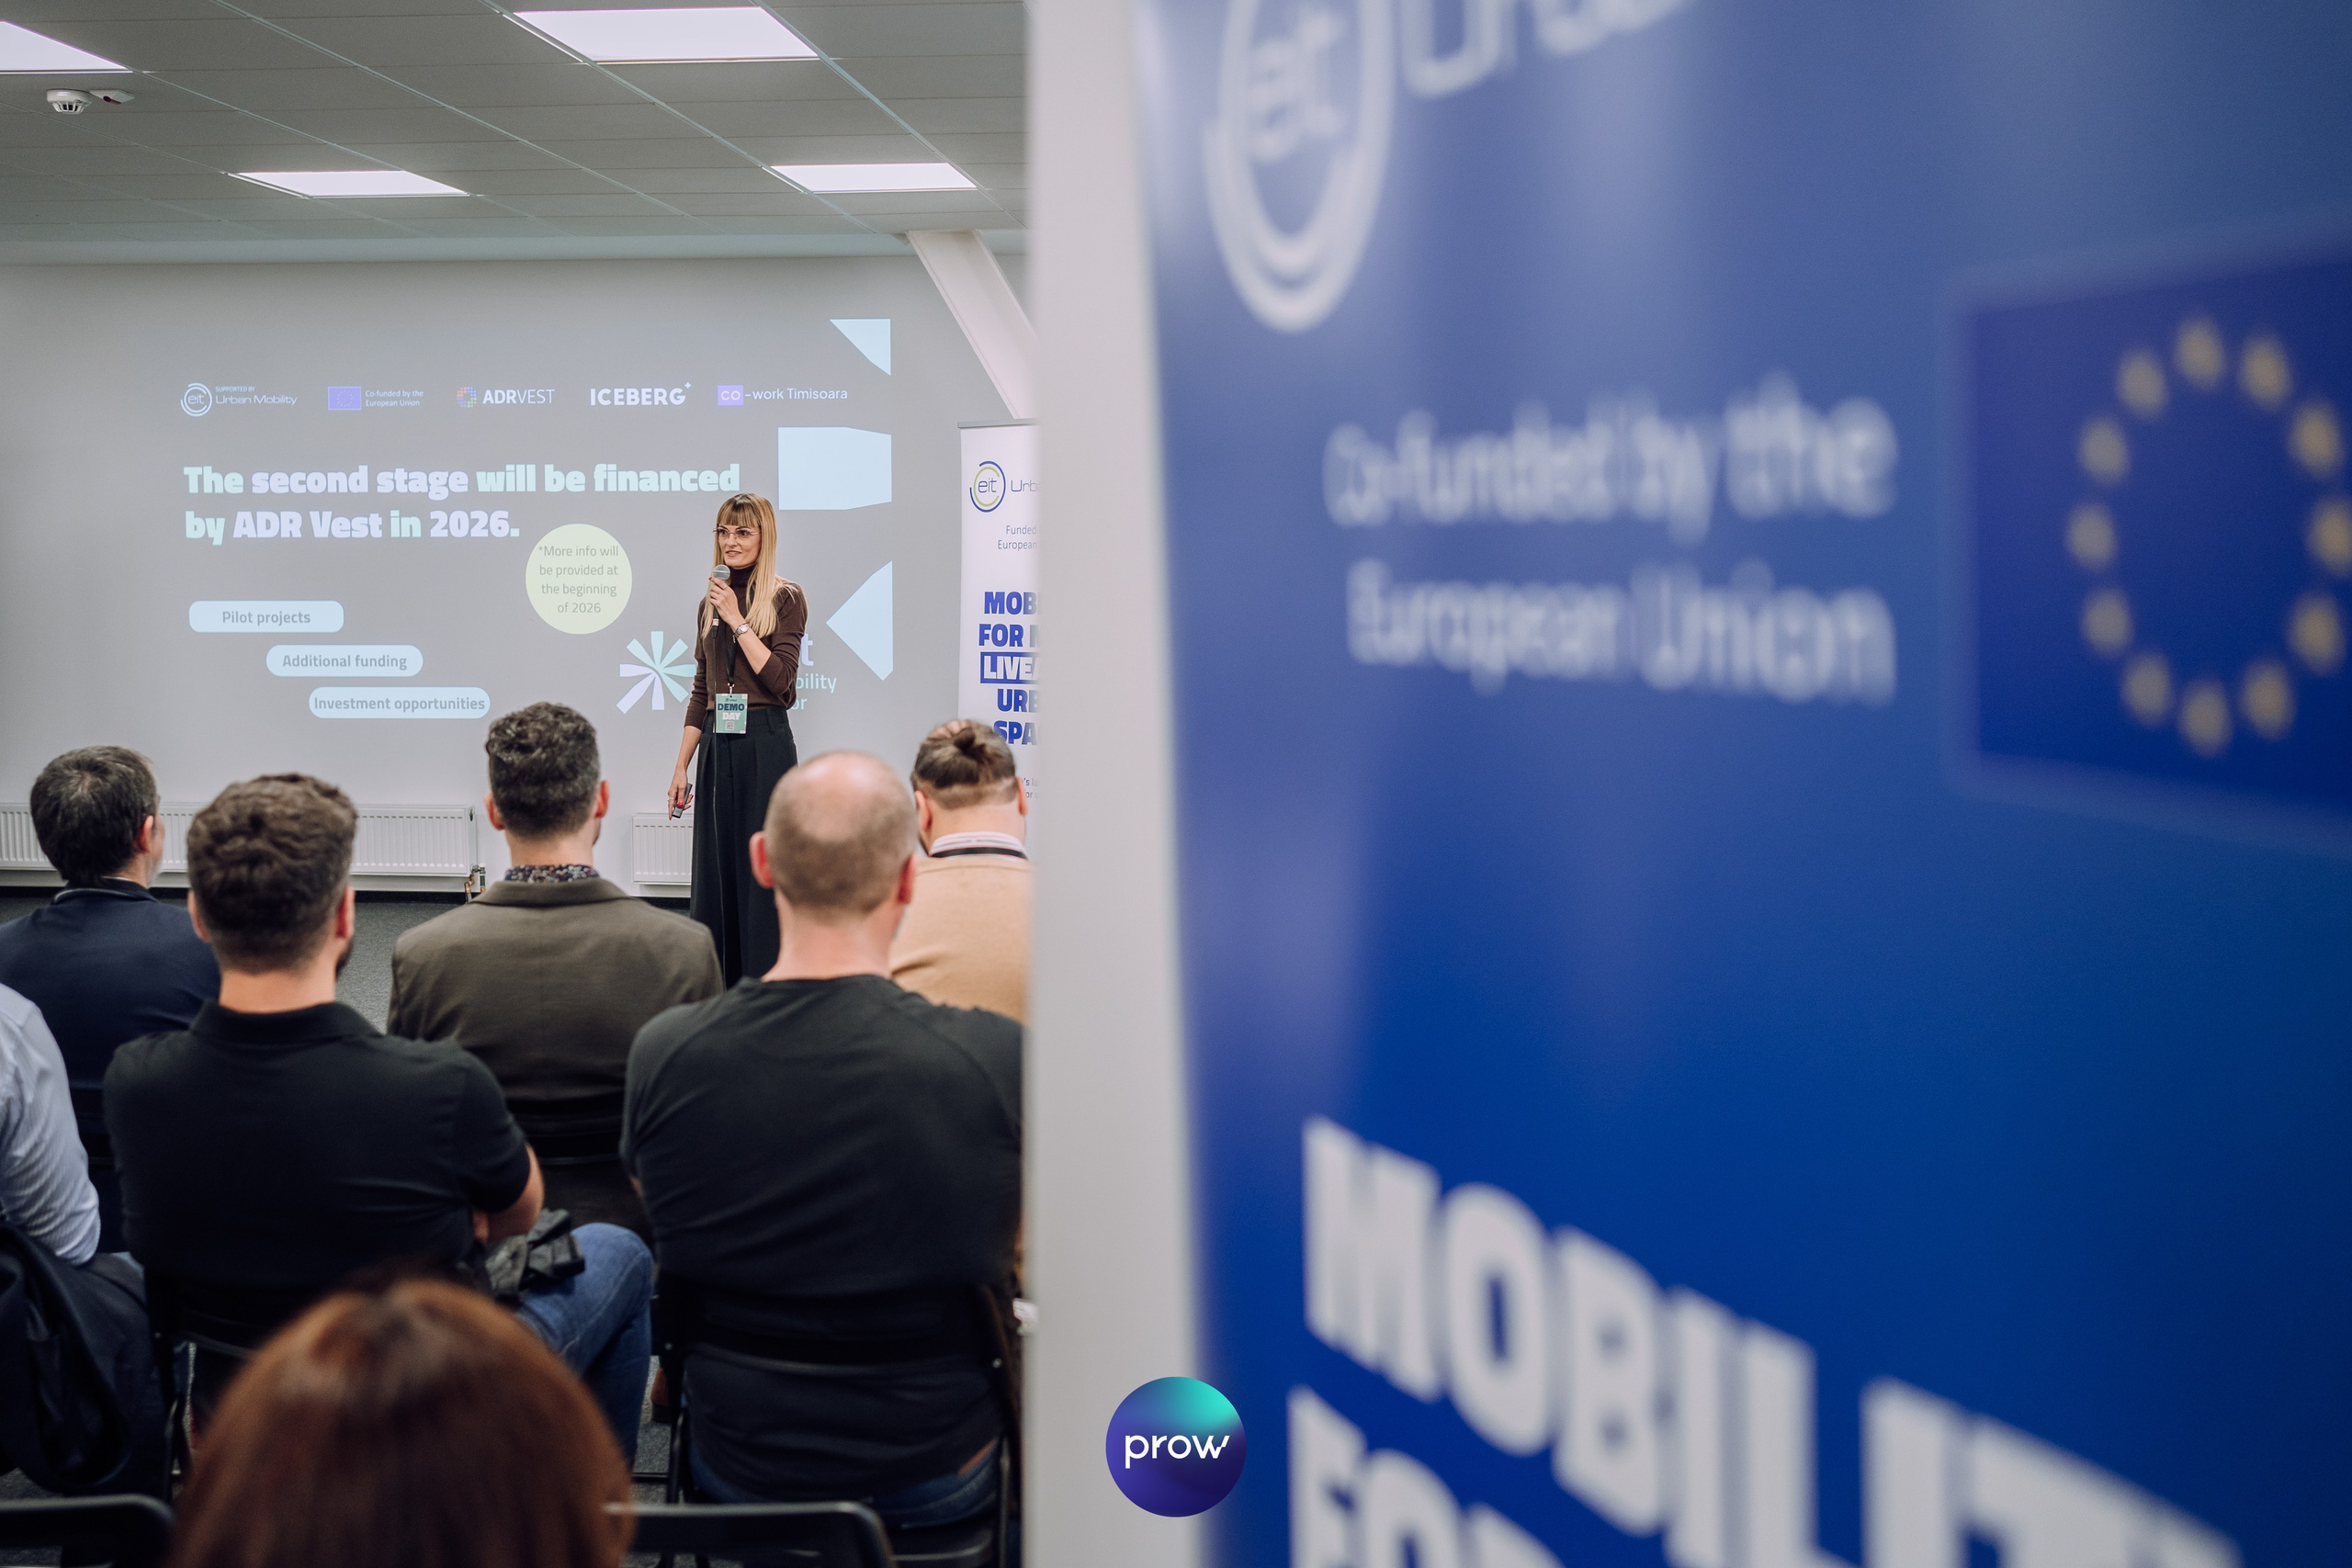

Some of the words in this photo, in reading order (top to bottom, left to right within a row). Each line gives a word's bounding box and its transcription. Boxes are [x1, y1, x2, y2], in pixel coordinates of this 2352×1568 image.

[187, 393, 206, 405] eit
[215, 395, 252, 404] Urban
[254, 394, 298, 405] Mobility
[365, 389, 401, 398] Co-funded
[401, 389, 411, 399] by
[412, 389, 424, 398] the
[786, 388, 848, 400] Timisoara
[365, 399, 399, 407] European
[400, 399, 420, 407] Union
[1723, 369, 1898, 520] the
[184, 466, 244, 493] The
[252, 465, 368, 493] second
[376, 468, 469, 501] stage
[476, 464, 537, 492] will
[544, 464, 586, 492] be
[594, 463, 741, 492] financed
[978, 478, 998, 493] eit
[185, 511, 226, 546] by
[232, 511, 302, 538] ADR
[309, 511, 382, 538] Vest
[390, 510, 422, 537] in
[429, 510, 520, 538] 2026.
[1005, 525, 1037, 535] Funded
[576, 545, 597, 557] info
[600, 546, 619, 557] will
[997, 539, 1038, 551] European
[539, 564, 553, 576] be
[556, 564, 605, 578] provided
[606, 565, 618, 576] at
[541, 583, 560, 594] the
[562, 583, 617, 598] beginning
[557, 602, 570, 614] of
[571, 603, 602, 614] 2026
[221, 610, 254, 625] Pilot
[256, 610, 311, 626] projects
[978, 623, 1024, 647] FOR
[1347, 557, 1623, 695] European
[1630, 557, 1897, 708] Union
[282, 654, 351, 668] Additional
[354, 654, 408, 671] funding
[313, 696, 391, 710] Investment
[393, 696, 486, 714] opportunities
[717, 703, 745, 712] DEMO
[722, 712, 741, 720] DAY
